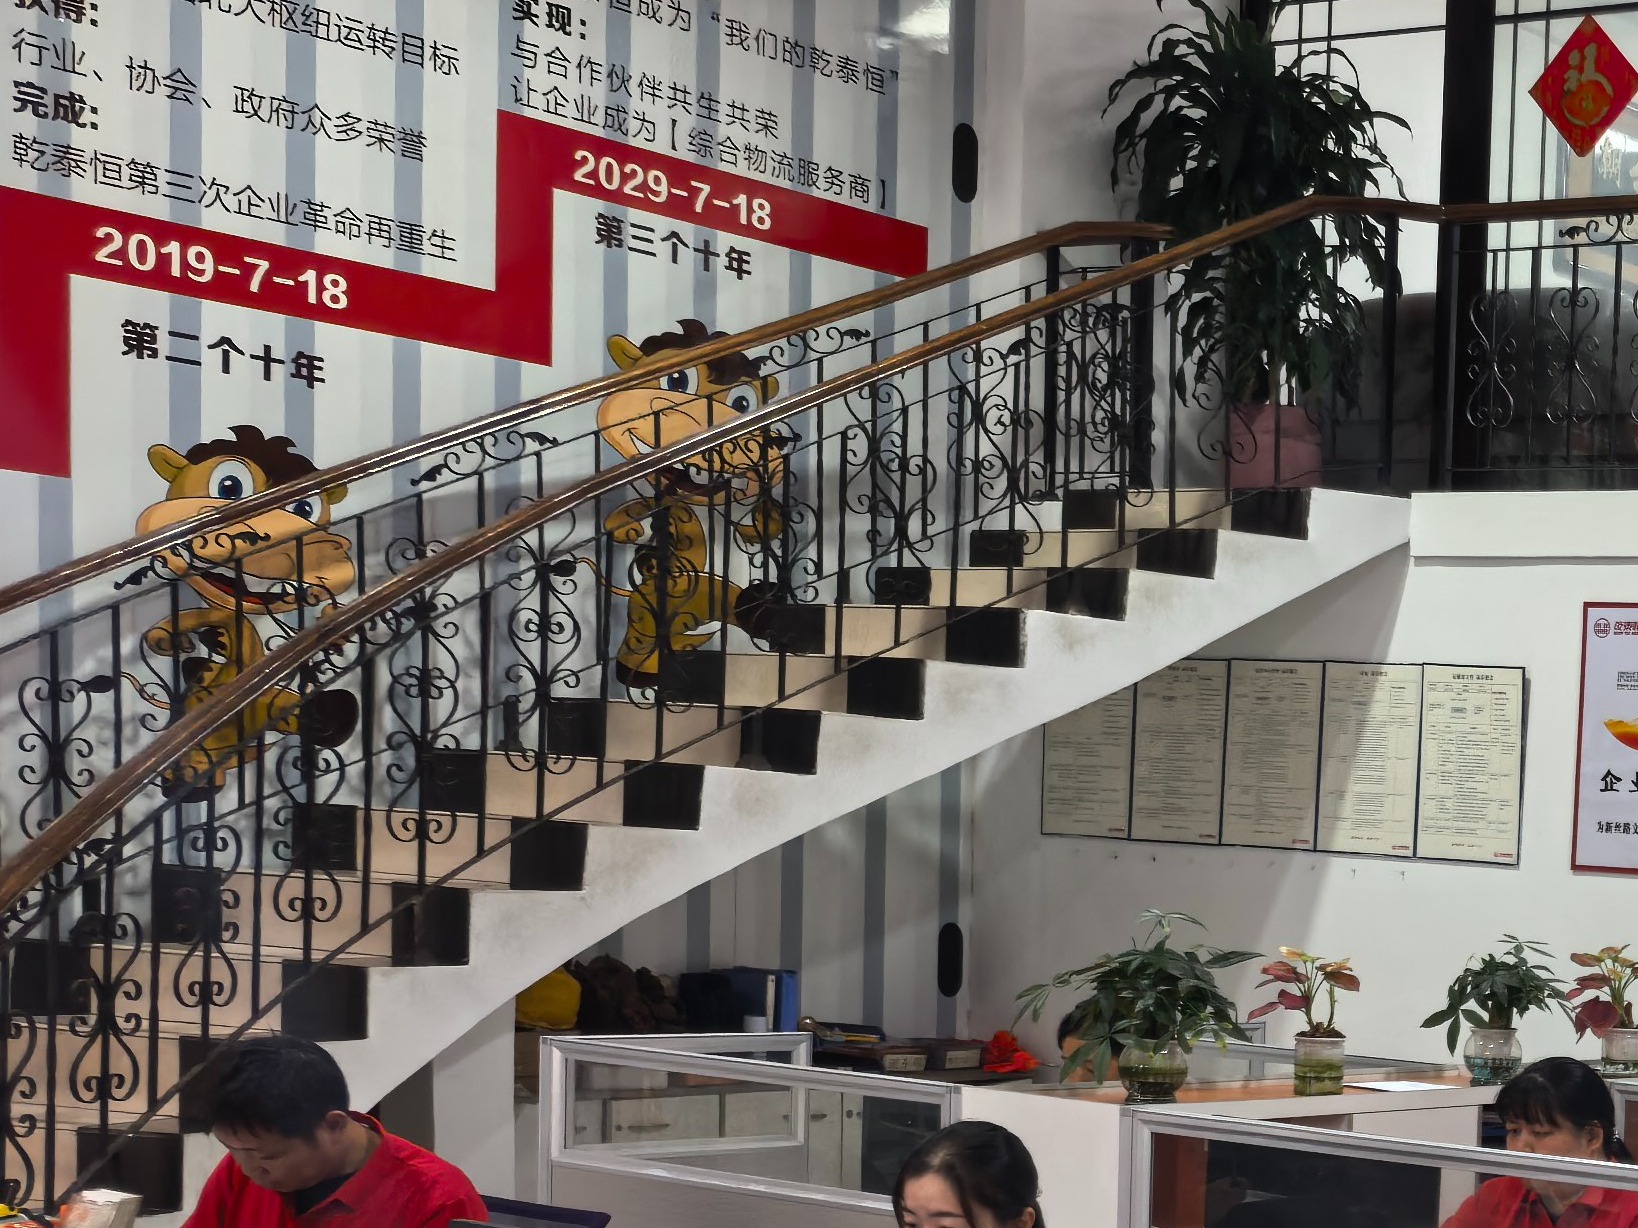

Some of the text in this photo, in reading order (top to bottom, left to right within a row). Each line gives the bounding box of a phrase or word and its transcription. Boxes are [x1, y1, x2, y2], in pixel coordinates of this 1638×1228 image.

[12, 27, 428, 163] 行业、协会、政府众多荣誉
[511, 34, 780, 140] 与合作伙伴共生共荣
[12, 132, 459, 263] 乾泰恒第三次企业革命再重生
[573, 150, 772, 231] 2029-7-18
[94, 226, 349, 311] 2019-7-18
[594, 213, 753, 281] 第三个十年
[120, 318, 327, 390] 第二个十年
